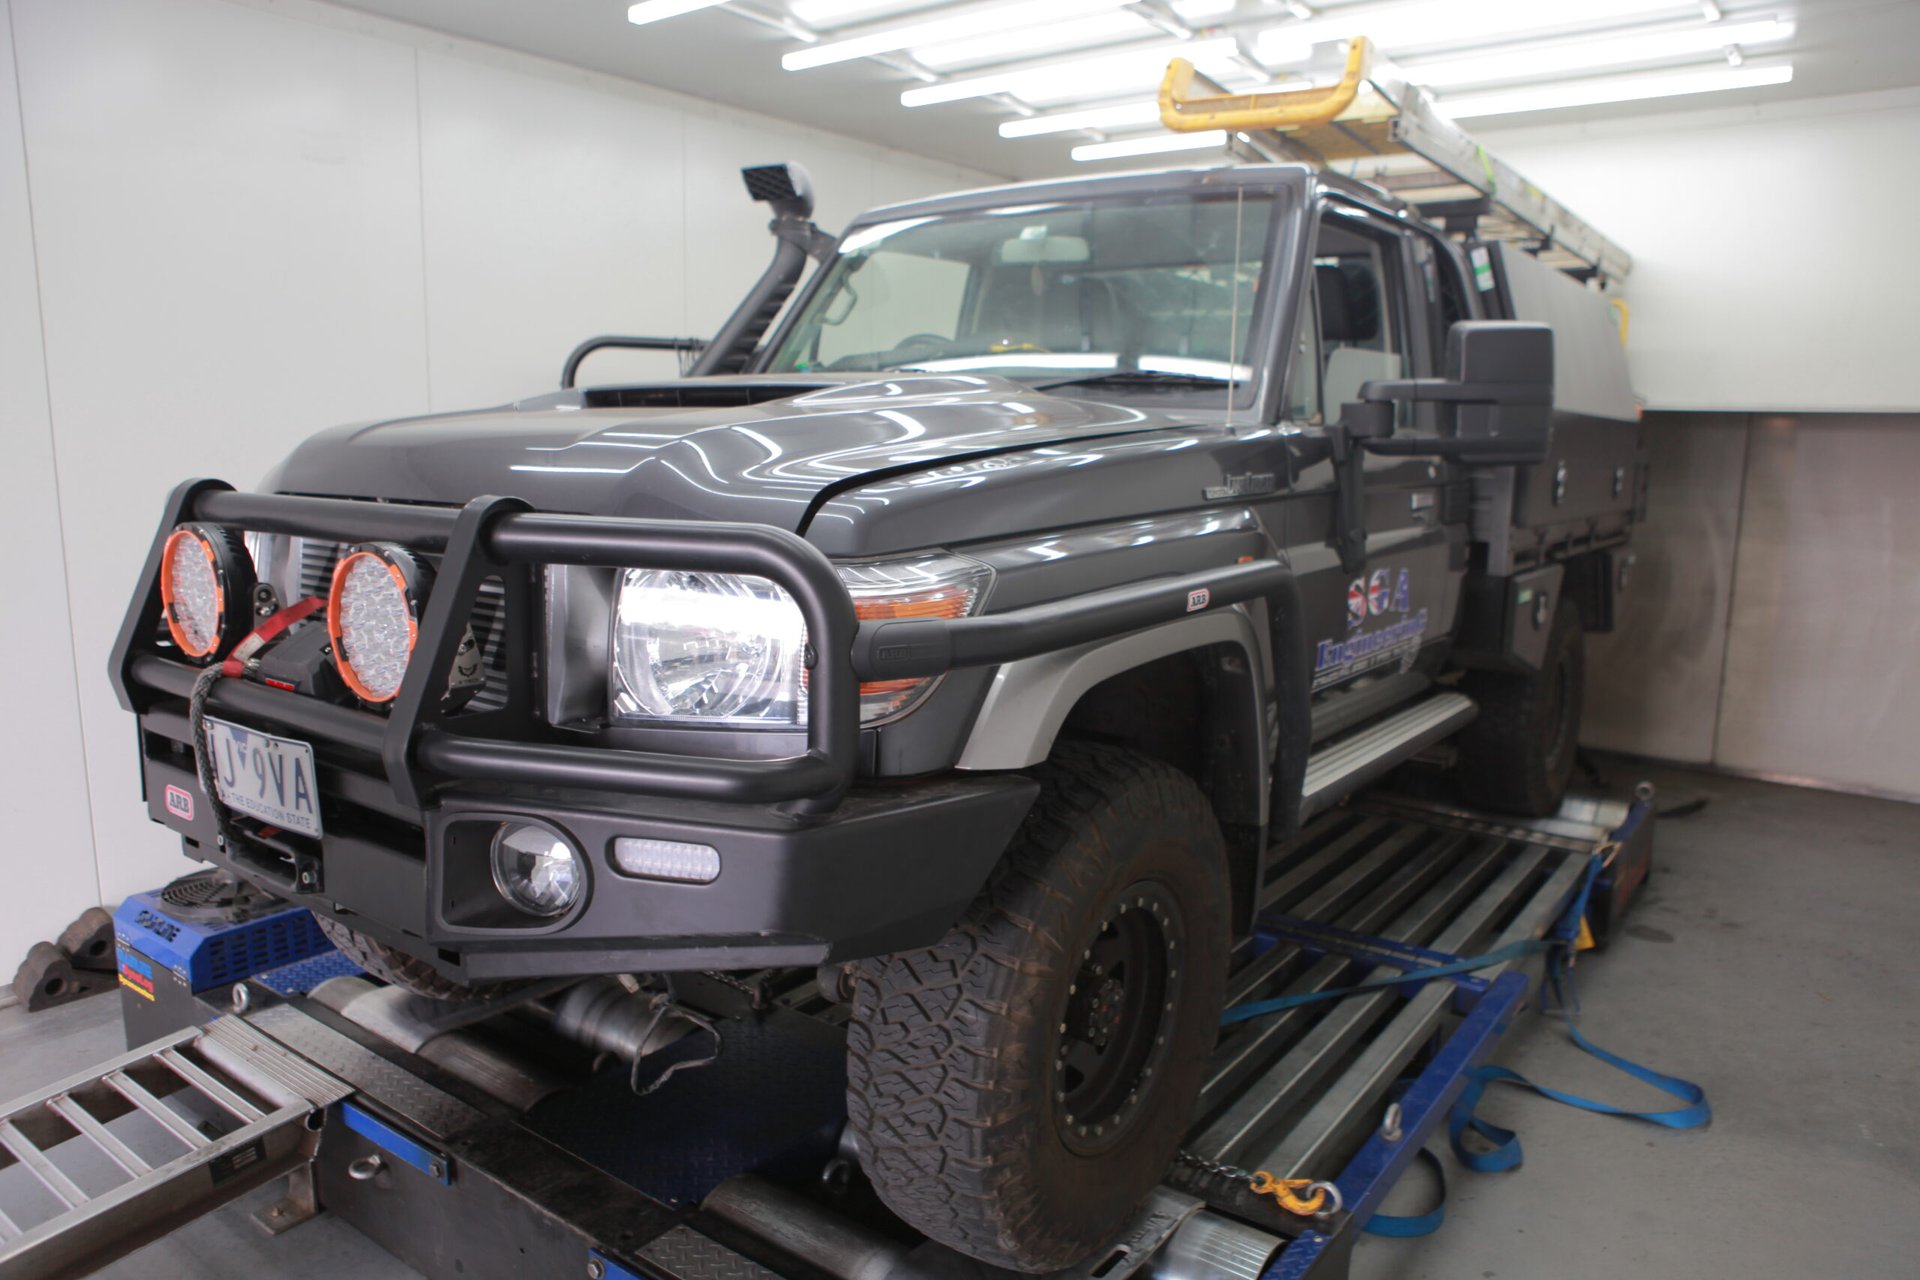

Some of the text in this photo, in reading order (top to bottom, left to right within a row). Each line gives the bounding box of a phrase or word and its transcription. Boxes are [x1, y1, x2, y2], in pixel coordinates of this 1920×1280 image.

[1347, 566, 1409, 629] SGA
[246, 797, 285, 820] EDUCATION
[286, 813, 311, 828] STATE
